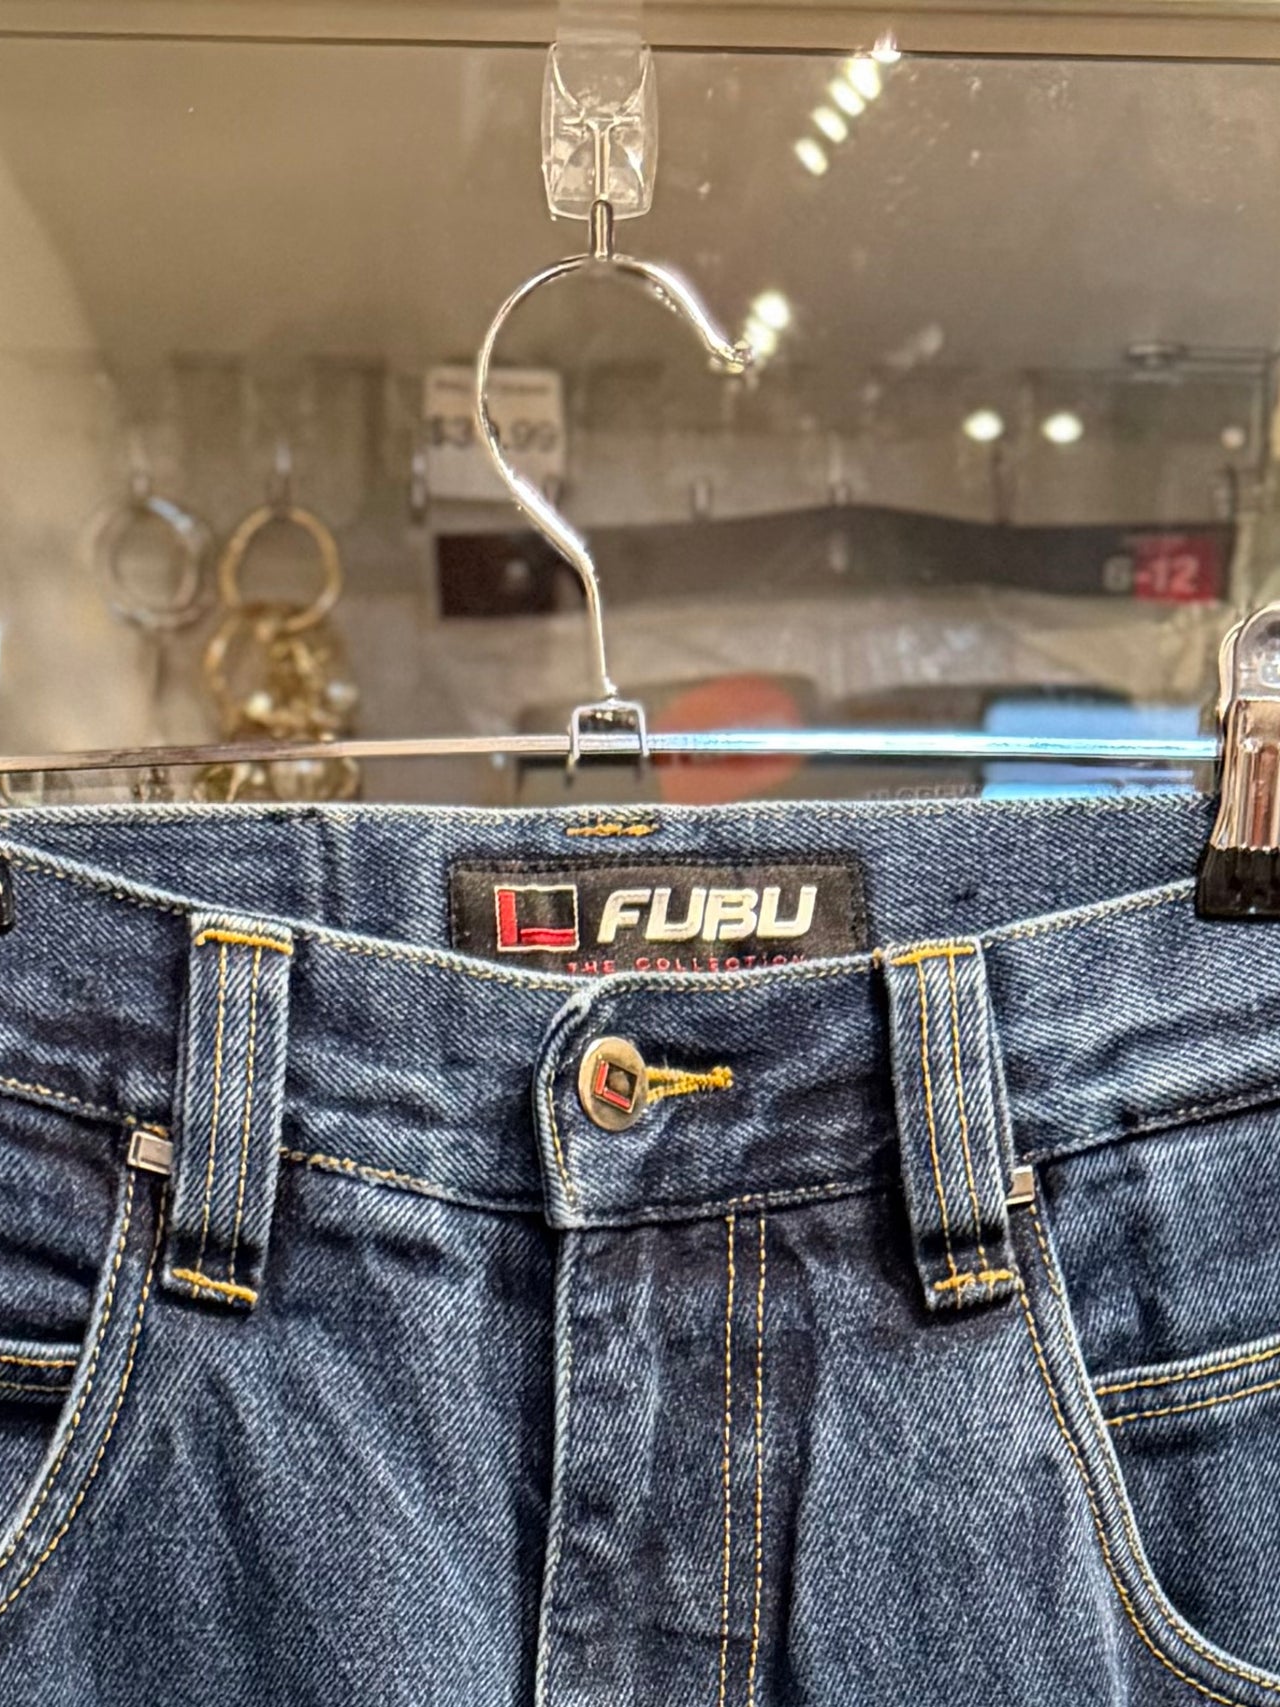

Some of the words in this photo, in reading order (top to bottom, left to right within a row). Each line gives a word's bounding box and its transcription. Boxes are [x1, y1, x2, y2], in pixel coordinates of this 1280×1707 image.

[431, 415, 558, 453] $3.99
[597, 885, 818, 944] FUBU
[566, 960, 617, 974] THE
[634, 954, 806, 973] COLLECTION
